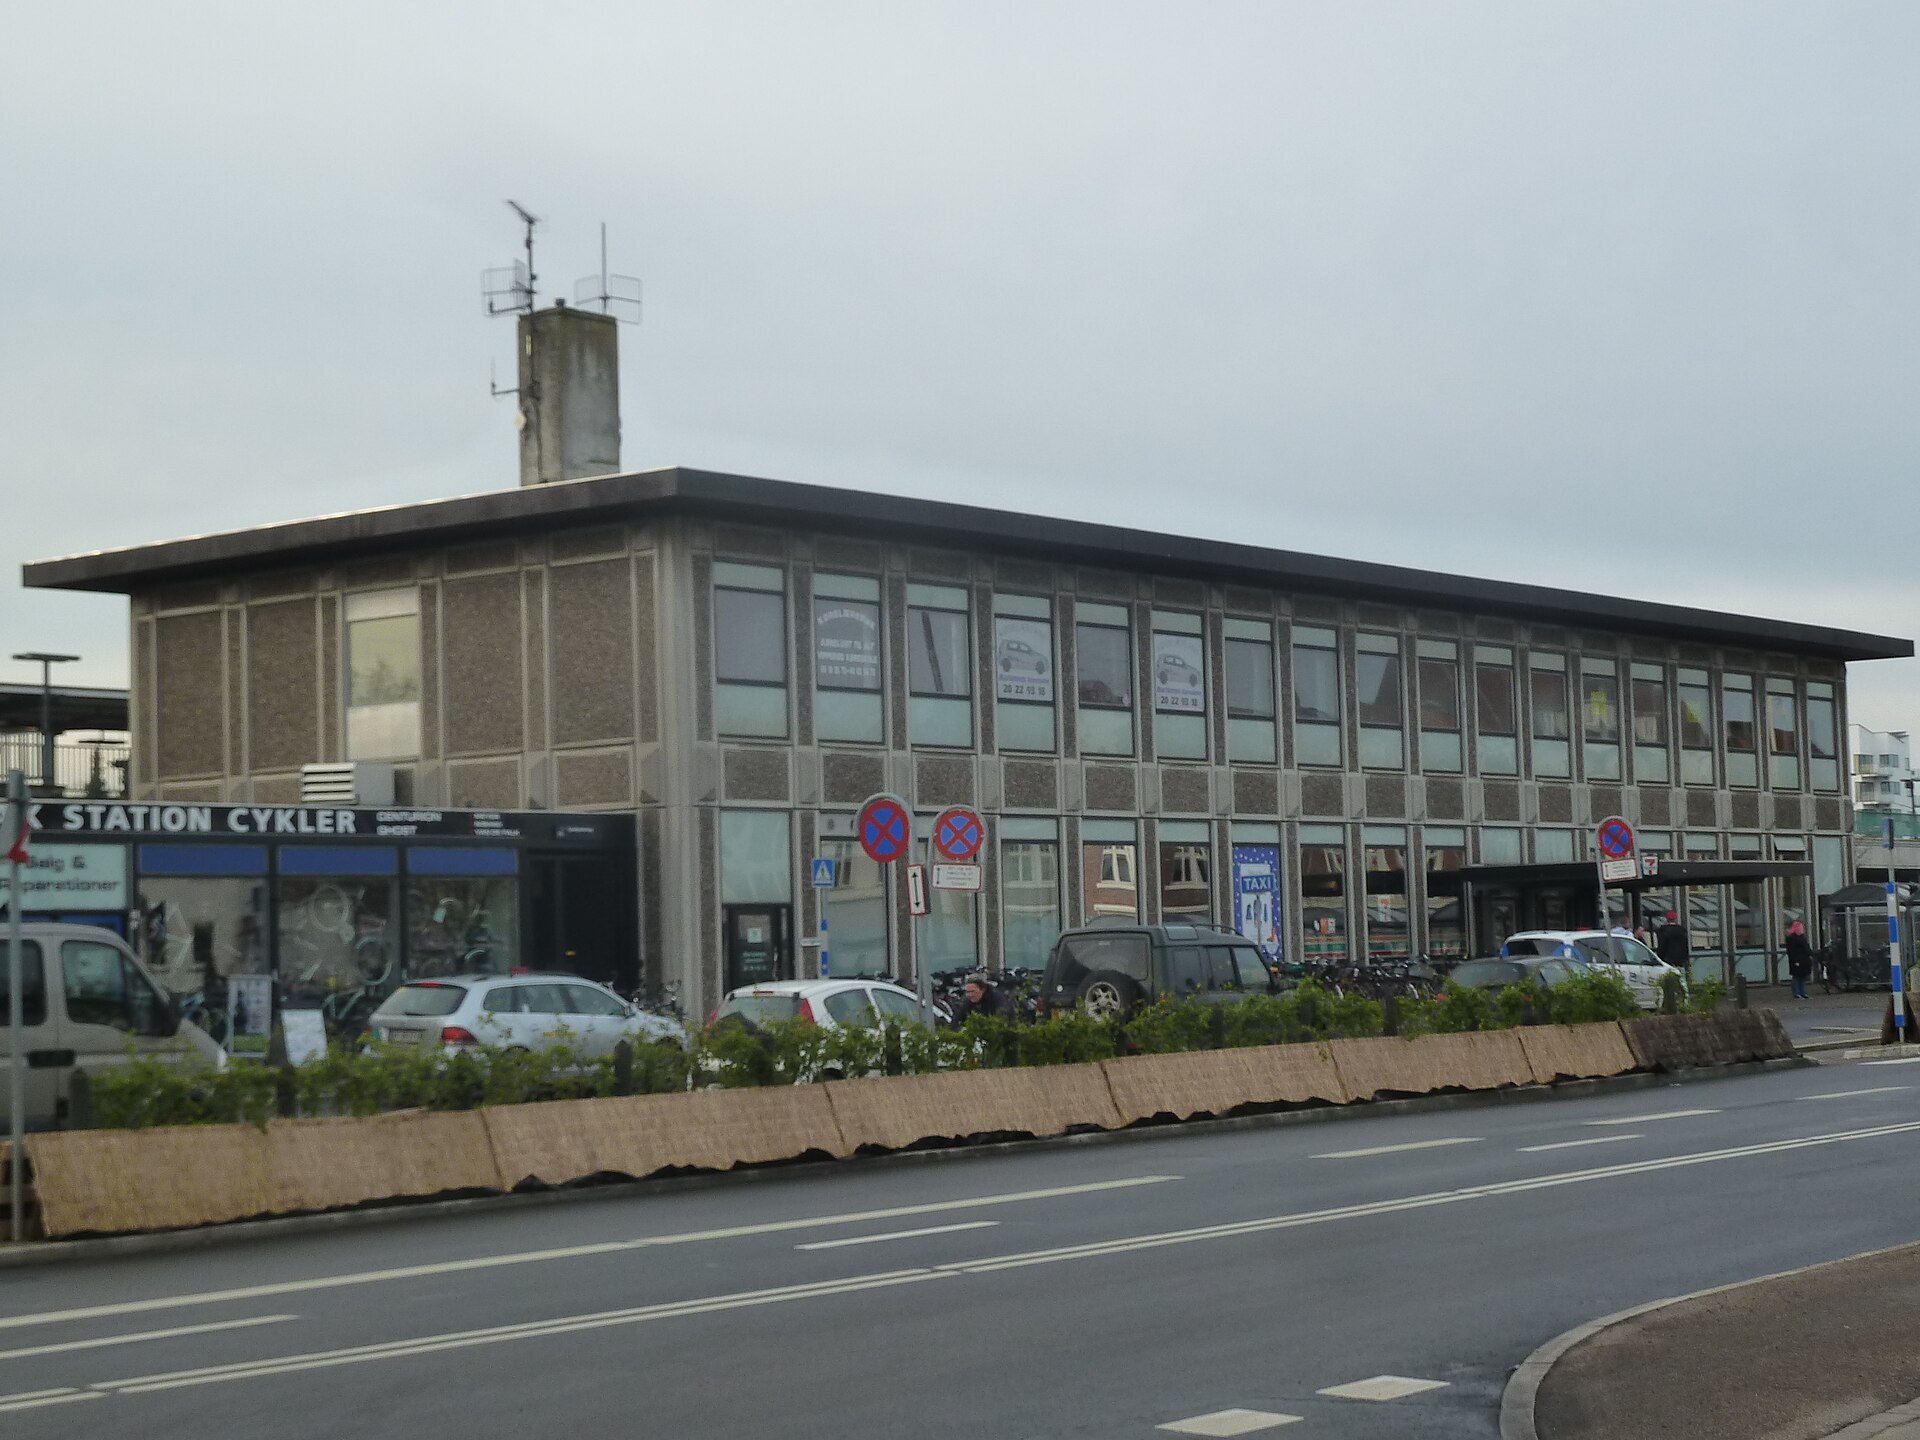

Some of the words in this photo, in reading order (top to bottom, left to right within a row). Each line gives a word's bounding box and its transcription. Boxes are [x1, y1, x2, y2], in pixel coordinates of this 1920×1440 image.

[62, 804, 212, 832] STATION
[227, 807, 357, 834] CYKLER
[73, 856, 86, 869] &
[0, 879, 117, 893] Rparationer
[1244, 877, 1271, 890] TAXI
